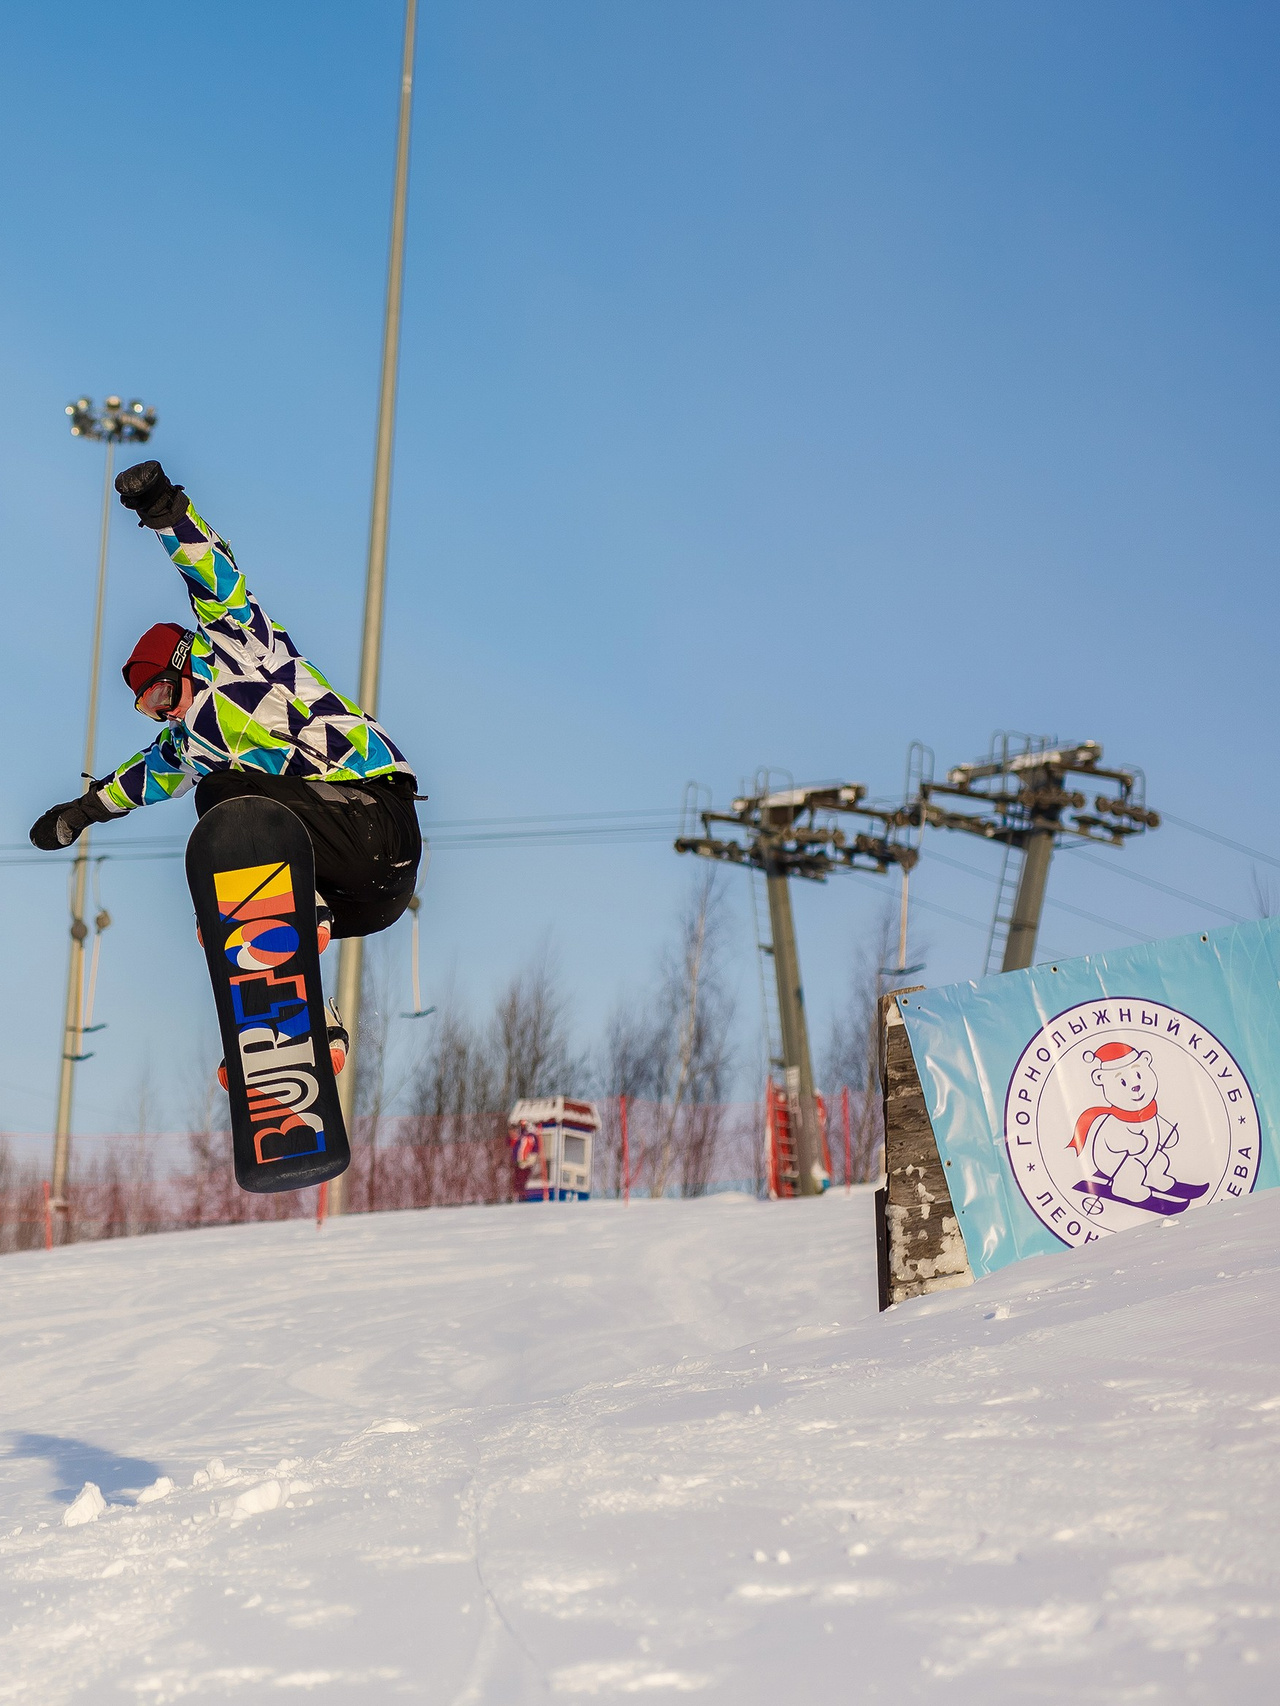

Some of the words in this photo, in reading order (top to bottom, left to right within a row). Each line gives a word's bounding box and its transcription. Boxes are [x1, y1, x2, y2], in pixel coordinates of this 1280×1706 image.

[214, 861, 326, 1164] BURTON
[1016, 1008, 1181, 1145] ГОРНОЛЫЖНЫЙ
[1188, 1033, 1243, 1104] КЛУБ
[1037, 1191, 1099, 1244] ЛЕОН
[1226, 1145, 1253, 1199] ЕВА
